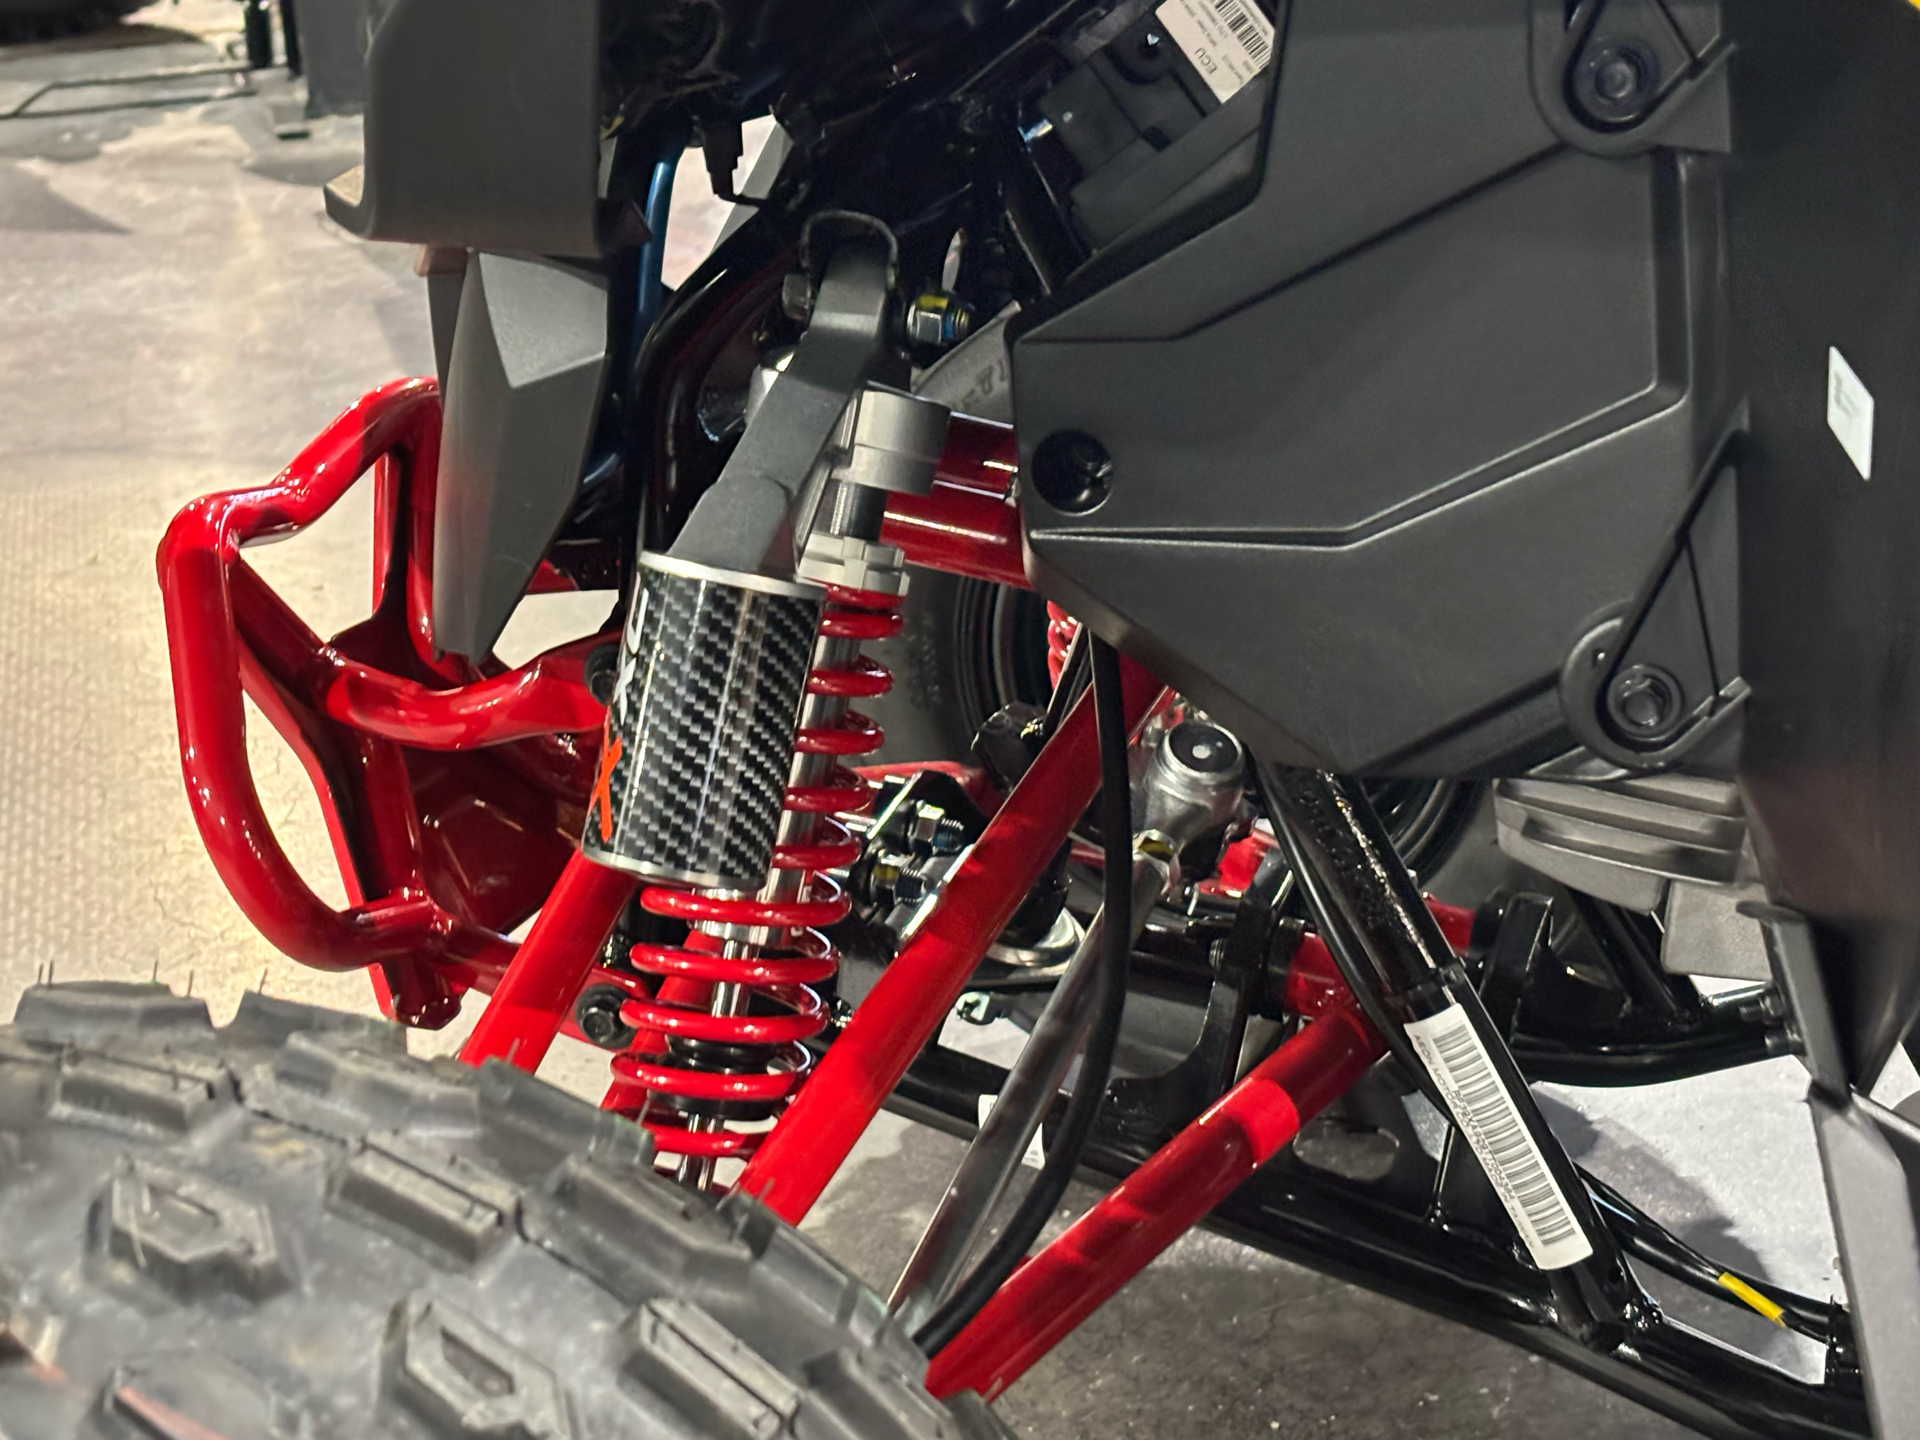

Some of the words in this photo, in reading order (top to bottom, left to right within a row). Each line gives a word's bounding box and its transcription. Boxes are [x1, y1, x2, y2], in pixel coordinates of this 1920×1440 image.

[1193, 46, 1218, 75] ECU
[1413, 1032, 1435, 1066] AEON
[1431, 1066, 1458, 1109] MOTOR
